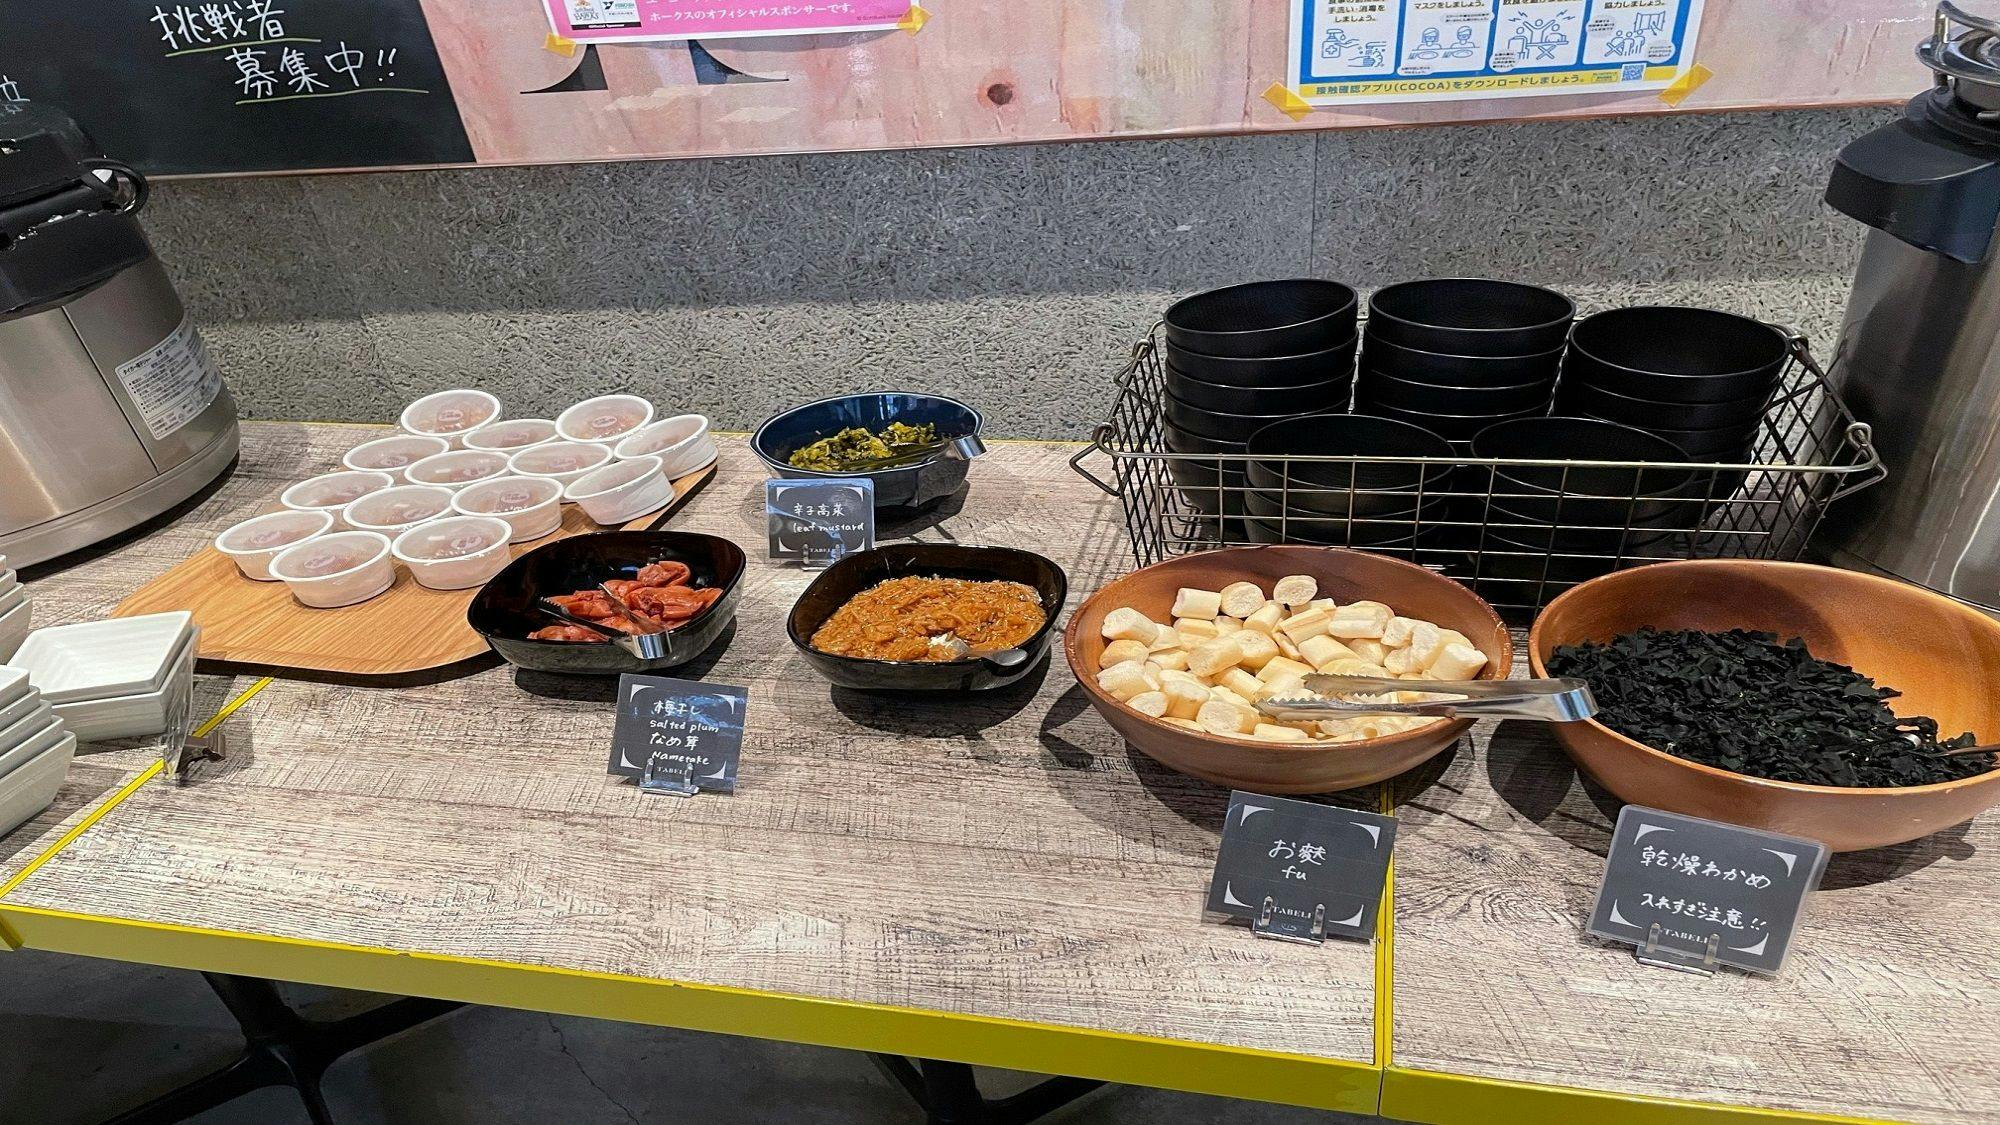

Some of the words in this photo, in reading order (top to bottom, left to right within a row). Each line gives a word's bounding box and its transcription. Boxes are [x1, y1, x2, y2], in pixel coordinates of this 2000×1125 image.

[650, 3, 856, 22] ホークスのオフィシャルスポンサーです。
[1414, 2, 1485, 10] マスクをしましょう。
[150, 0, 285, 50] 挑戦者
[1334, 15, 1377, 23] しましょう。
[793, 522, 816, 534] leaf
[819, 522, 865, 532] mustard
[690, 721, 719, 734] plum
[649, 731, 700, 751] なめ茸
[1281, 865, 1307, 881] fu
[1640, 845, 1772, 890] 乾燥わかめ
[1663, 928, 1708, 944] TABELI
